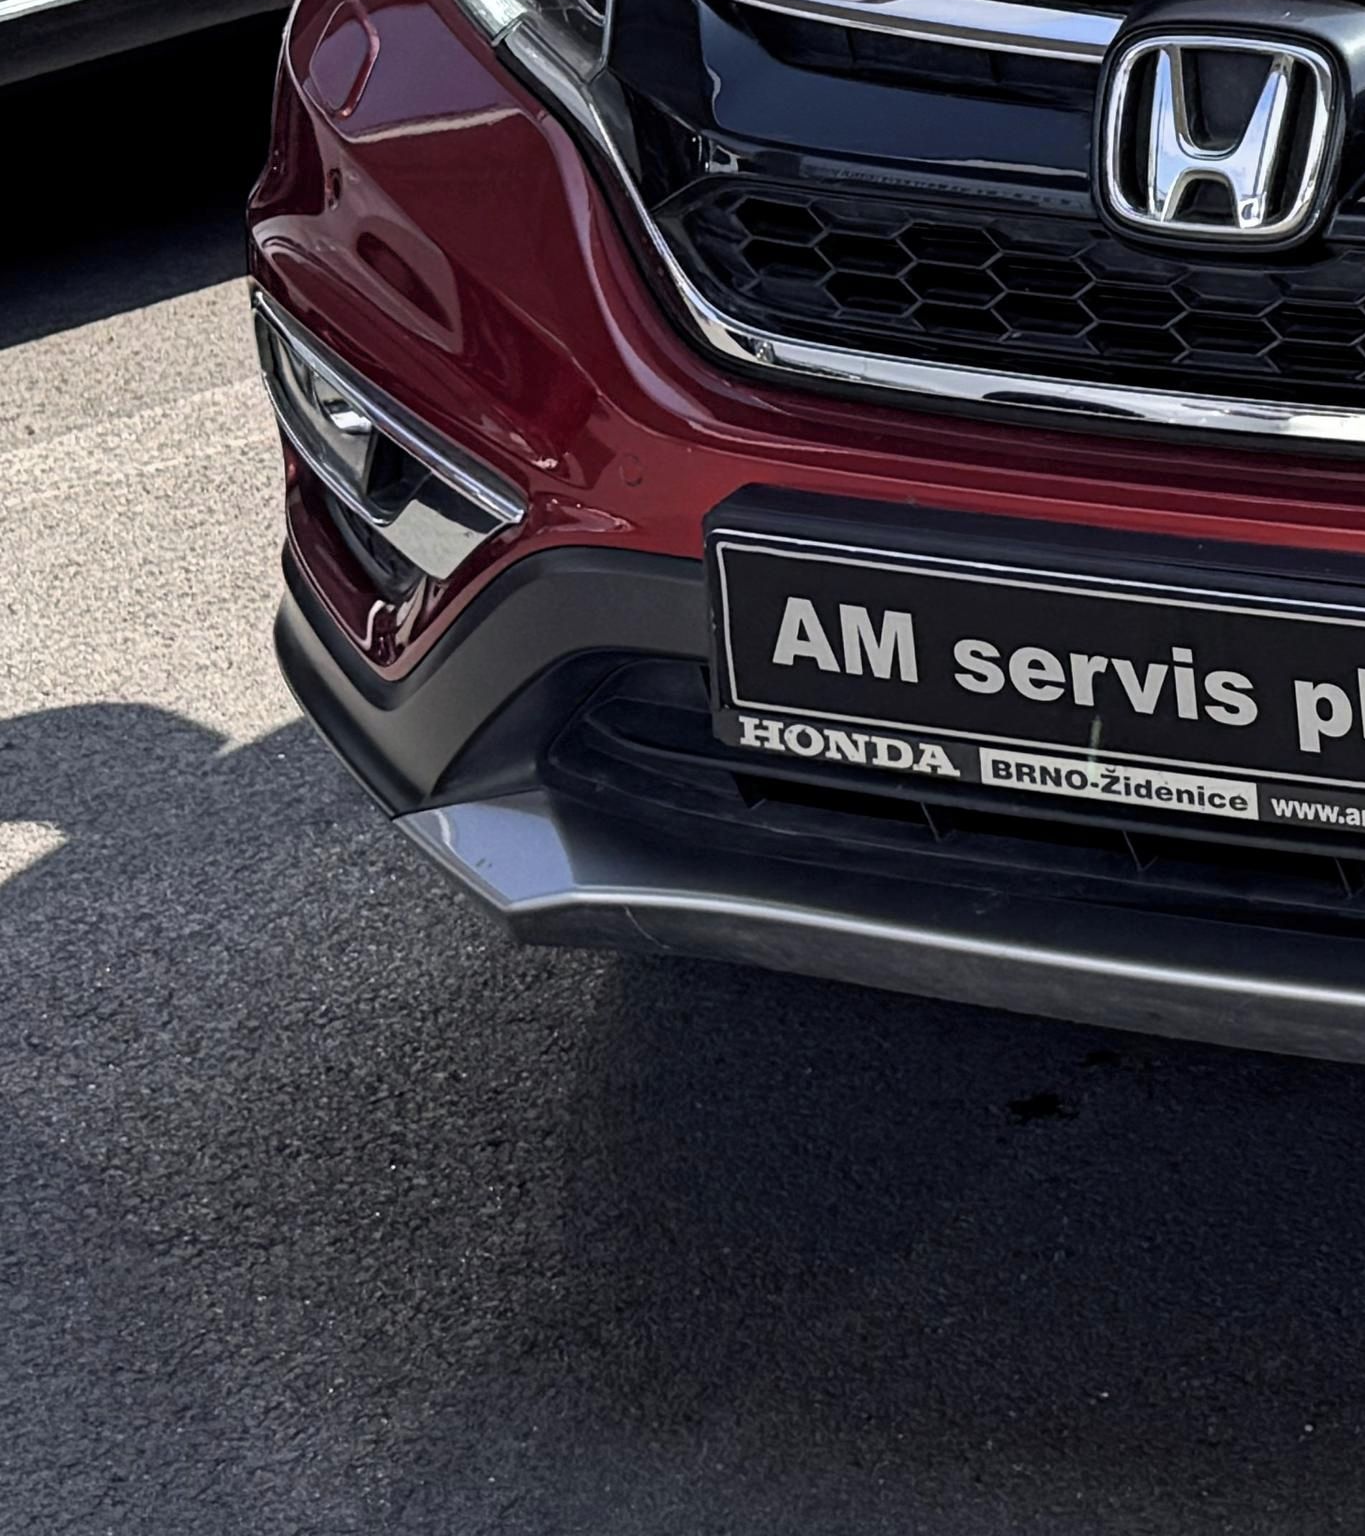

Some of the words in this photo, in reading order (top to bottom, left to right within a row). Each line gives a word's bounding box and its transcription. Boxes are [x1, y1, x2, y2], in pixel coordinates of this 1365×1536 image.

[772, 596, 919, 684] AM
[953, 638, 1259, 727] servis
[738, 715, 961, 777] HONDA
[990, 758, 1249, 812] BRNO-Židenice
